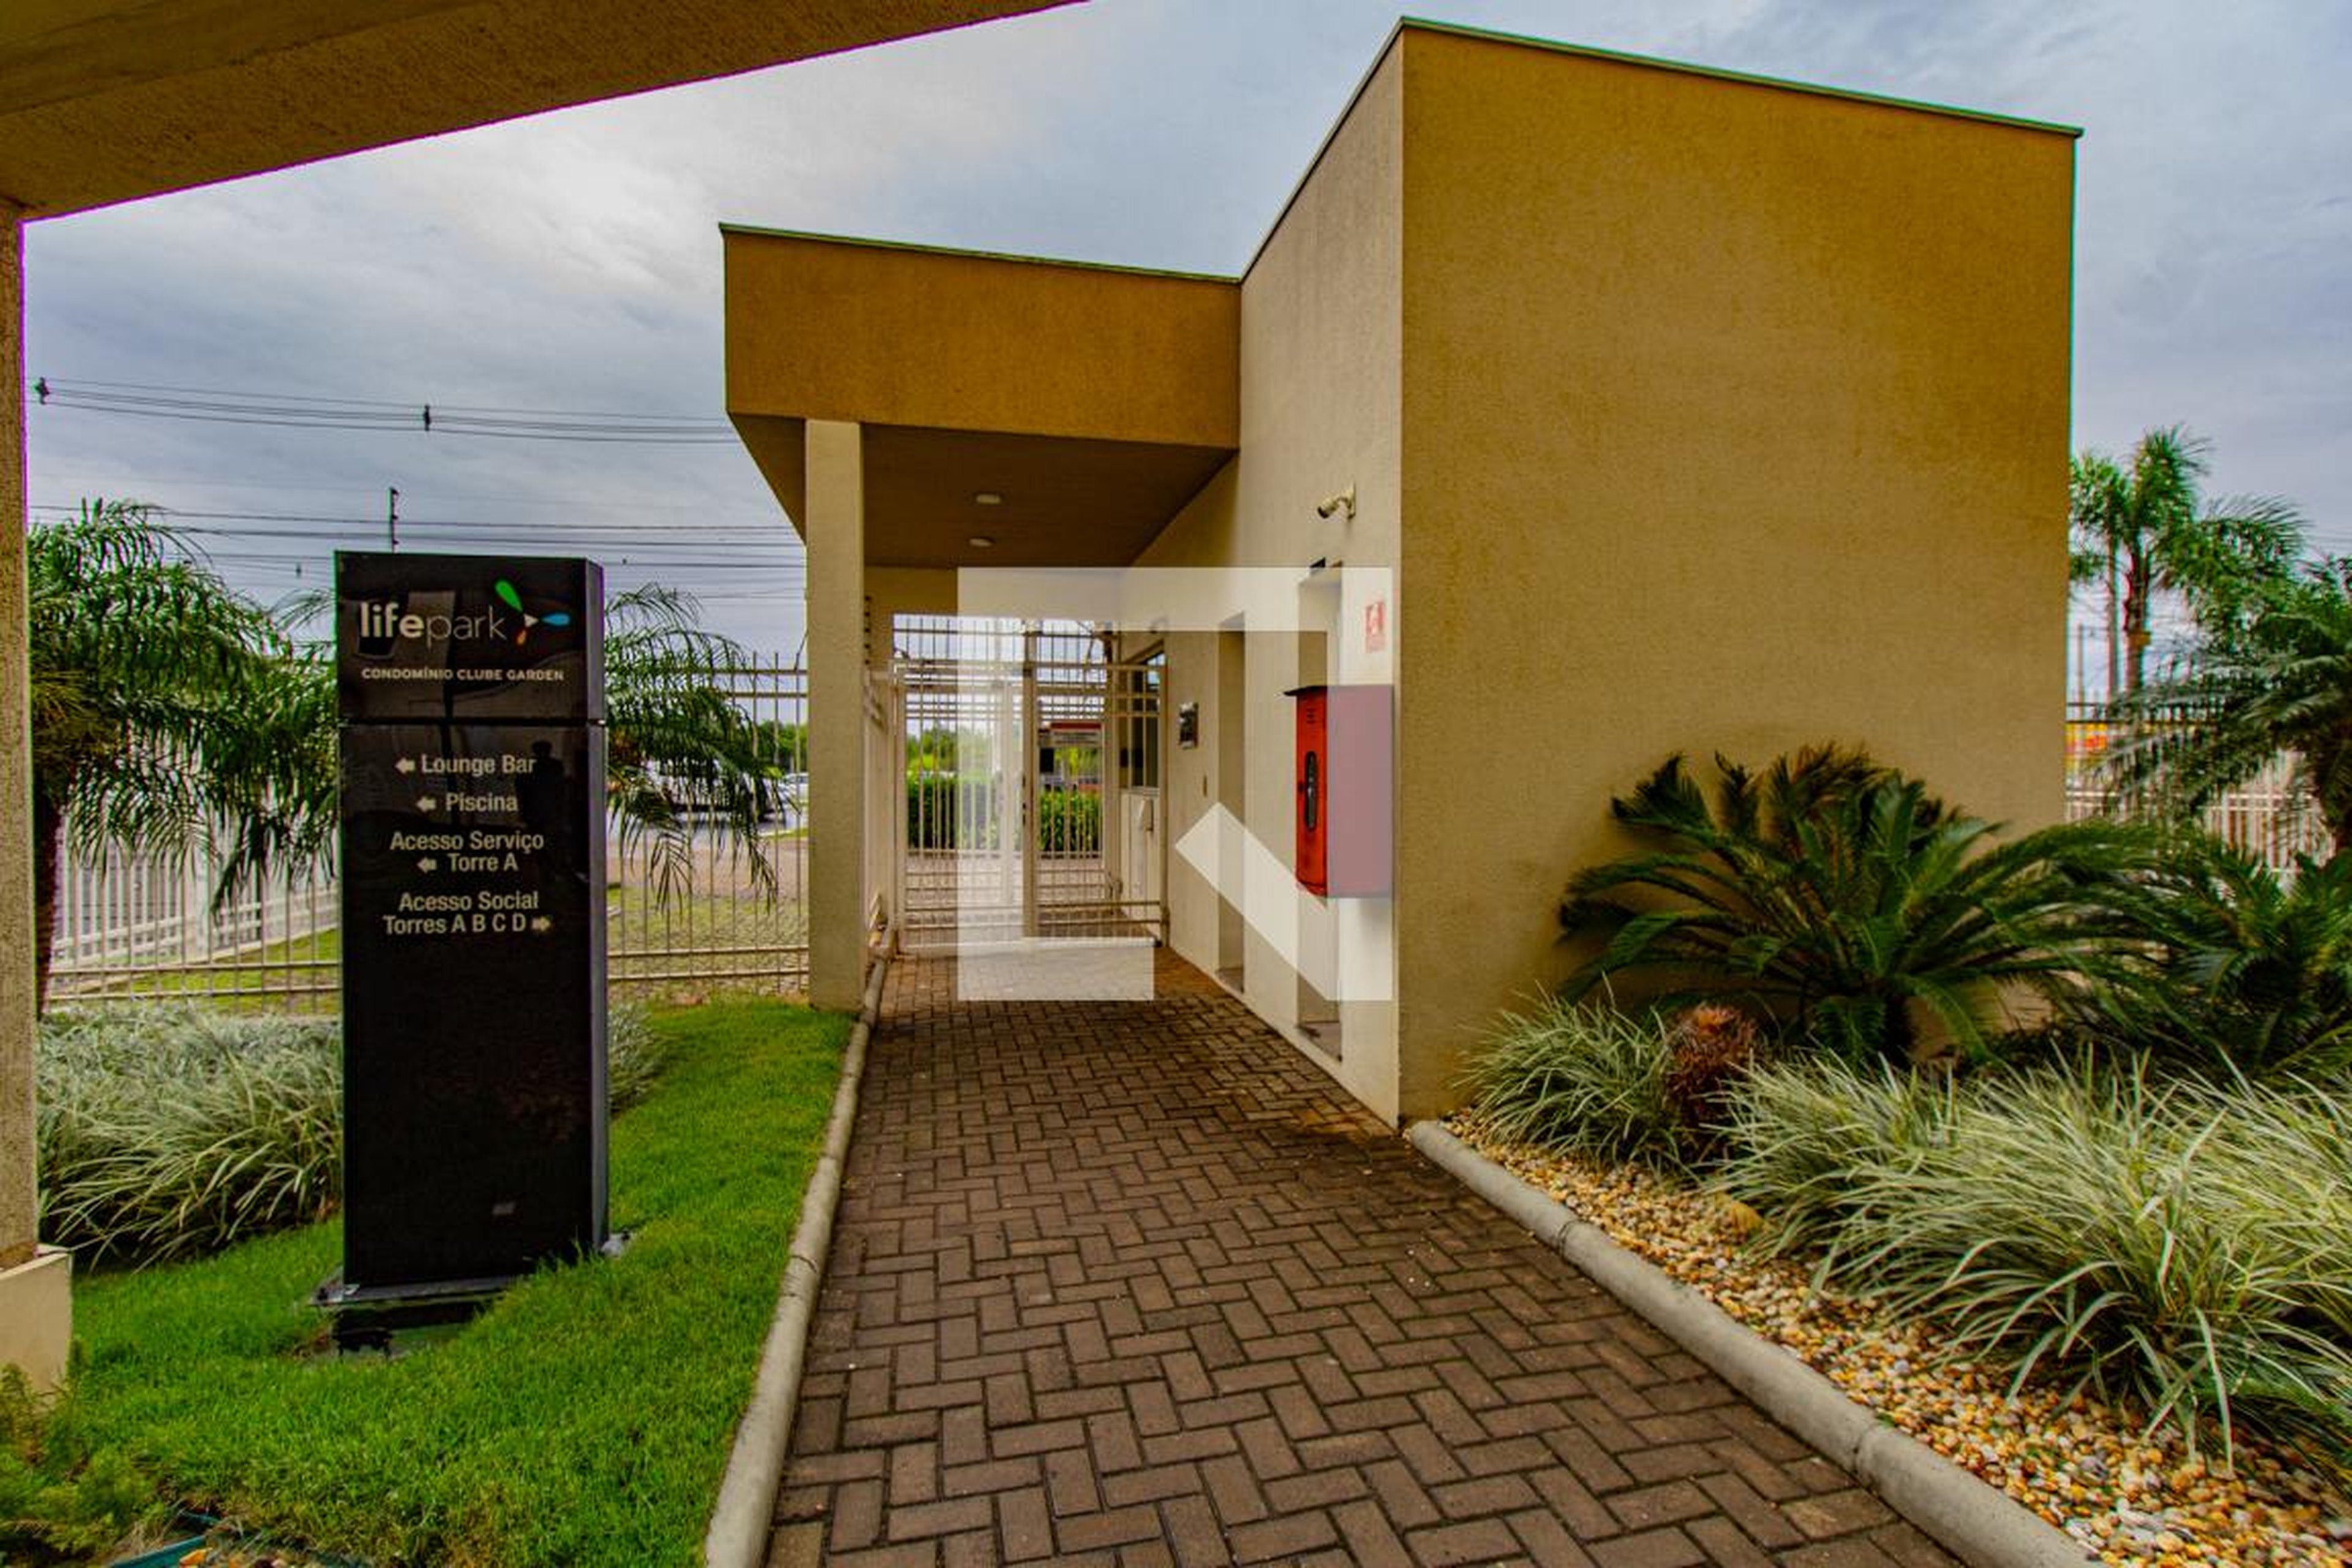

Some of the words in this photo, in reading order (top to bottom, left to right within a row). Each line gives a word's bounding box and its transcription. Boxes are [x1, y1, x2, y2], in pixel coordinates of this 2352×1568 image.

[360, 602, 508, 649] lifepark
[361, 667, 453, 680] CONDOMÍNIO
[457, 669, 502, 680] CLUBE
[507, 669, 564, 681] GARDEN
[421, 754, 496, 777] Lounge
[502, 754, 536, 773] Bar
[447, 793, 518, 812] Piscina
[390, 832, 464, 850] Acesso
[470, 831, 544, 854] Serviço
[448, 853, 499, 872] Torre
[504, 853, 518, 870] A
[399, 892, 472, 911] Acesso
[478, 891, 538, 910] Social
[383, 916, 447, 934] Torres
[451, 915, 466, 932] A
[472, 914, 486, 932] B
[492, 914, 507, 932] C
[513, 913, 526, 931] D
